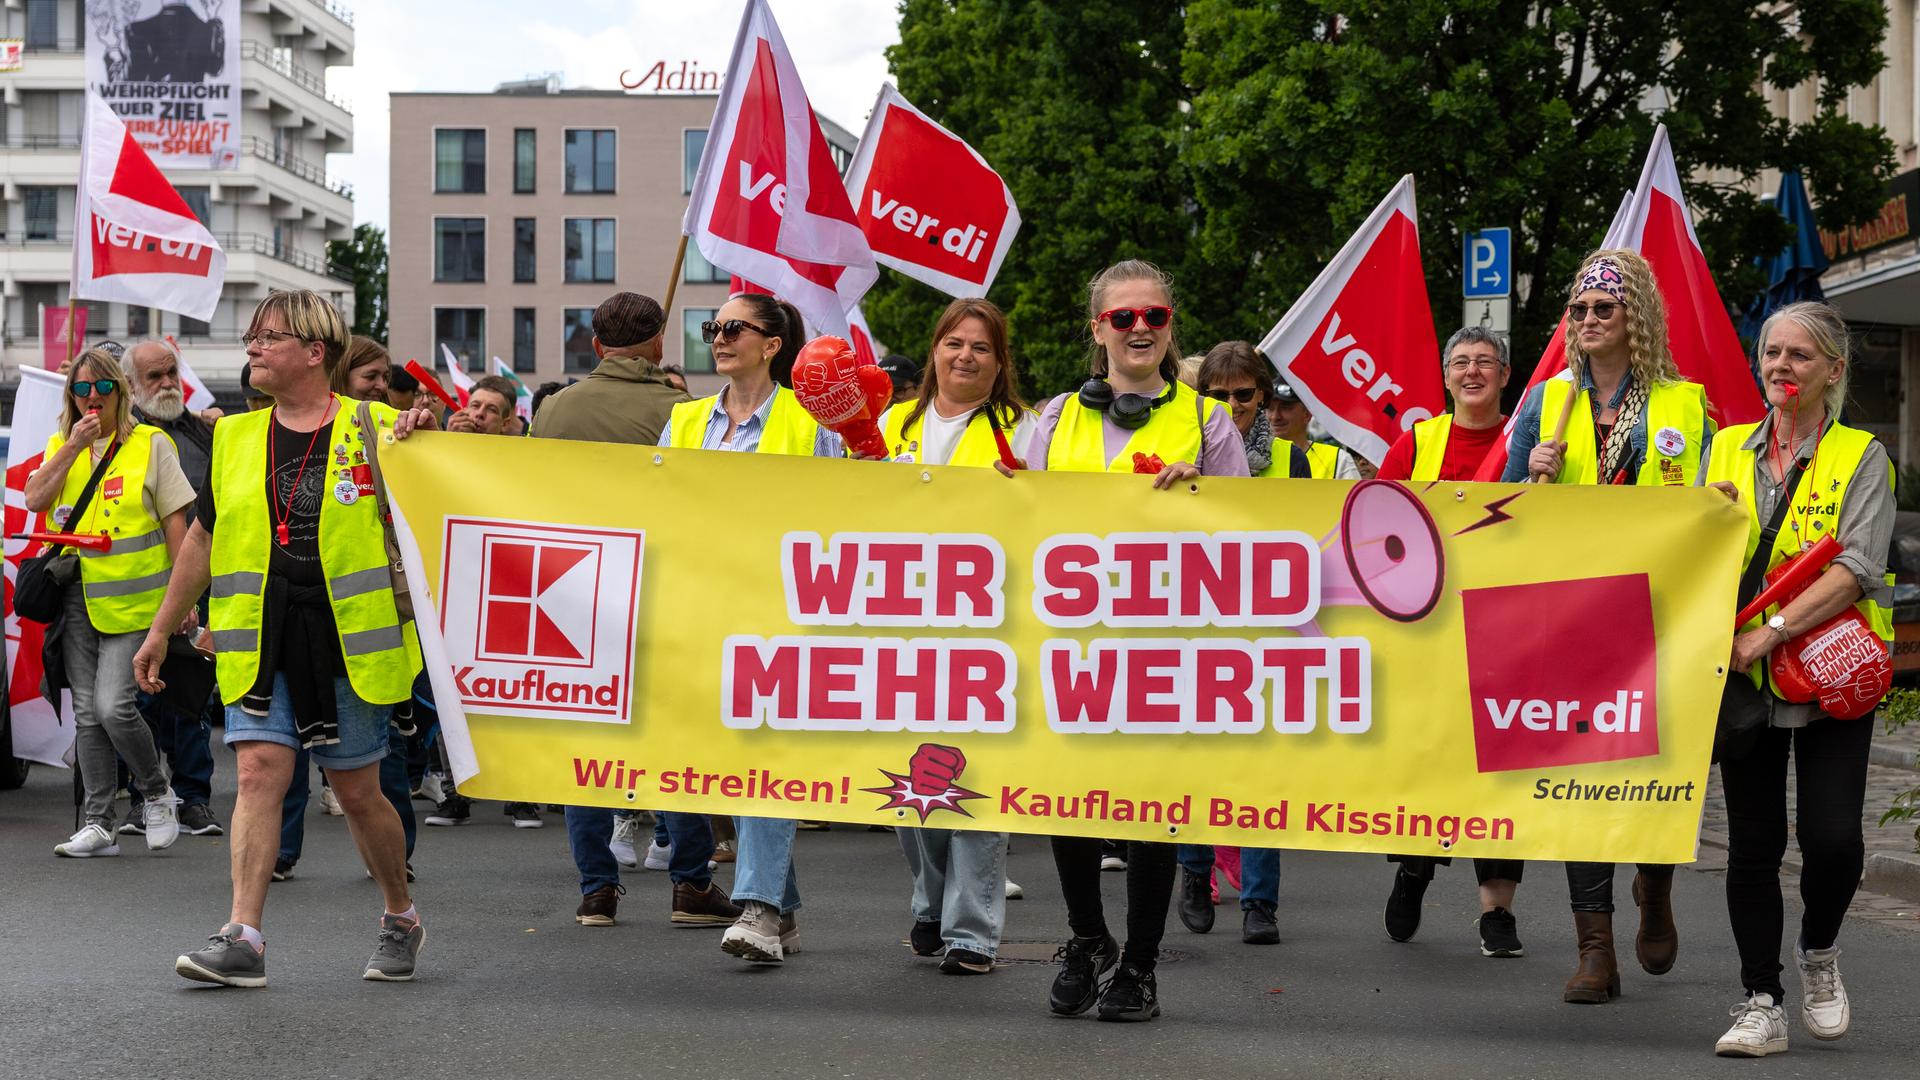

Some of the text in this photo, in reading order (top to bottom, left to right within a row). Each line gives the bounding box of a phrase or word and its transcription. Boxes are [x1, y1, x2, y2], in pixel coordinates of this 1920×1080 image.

[100, 84, 230, 99] WEHRPFLICHT
[620, 60, 725, 91] Adin
[160, 102, 205, 121] ZIEL
[155, 119, 231, 142] ZUKUNFT
[162, 140, 213, 155] SPIEL
[871, 190, 988, 264] ver.di
[1471, 238, 1496, 288] P
[1797, 503, 1839, 516] ver.di
[792, 541, 1310, 618] WIR SIND
[731, 645, 1361, 723] MEHR WERT!
[1484, 690, 1644, 734] ver.di
[573, 758, 850, 805] Wir streiken!
[1533, 778, 1695, 802] Schweinfurt
[1000, 785, 1515, 844] Kaufland Bad Kissingen
